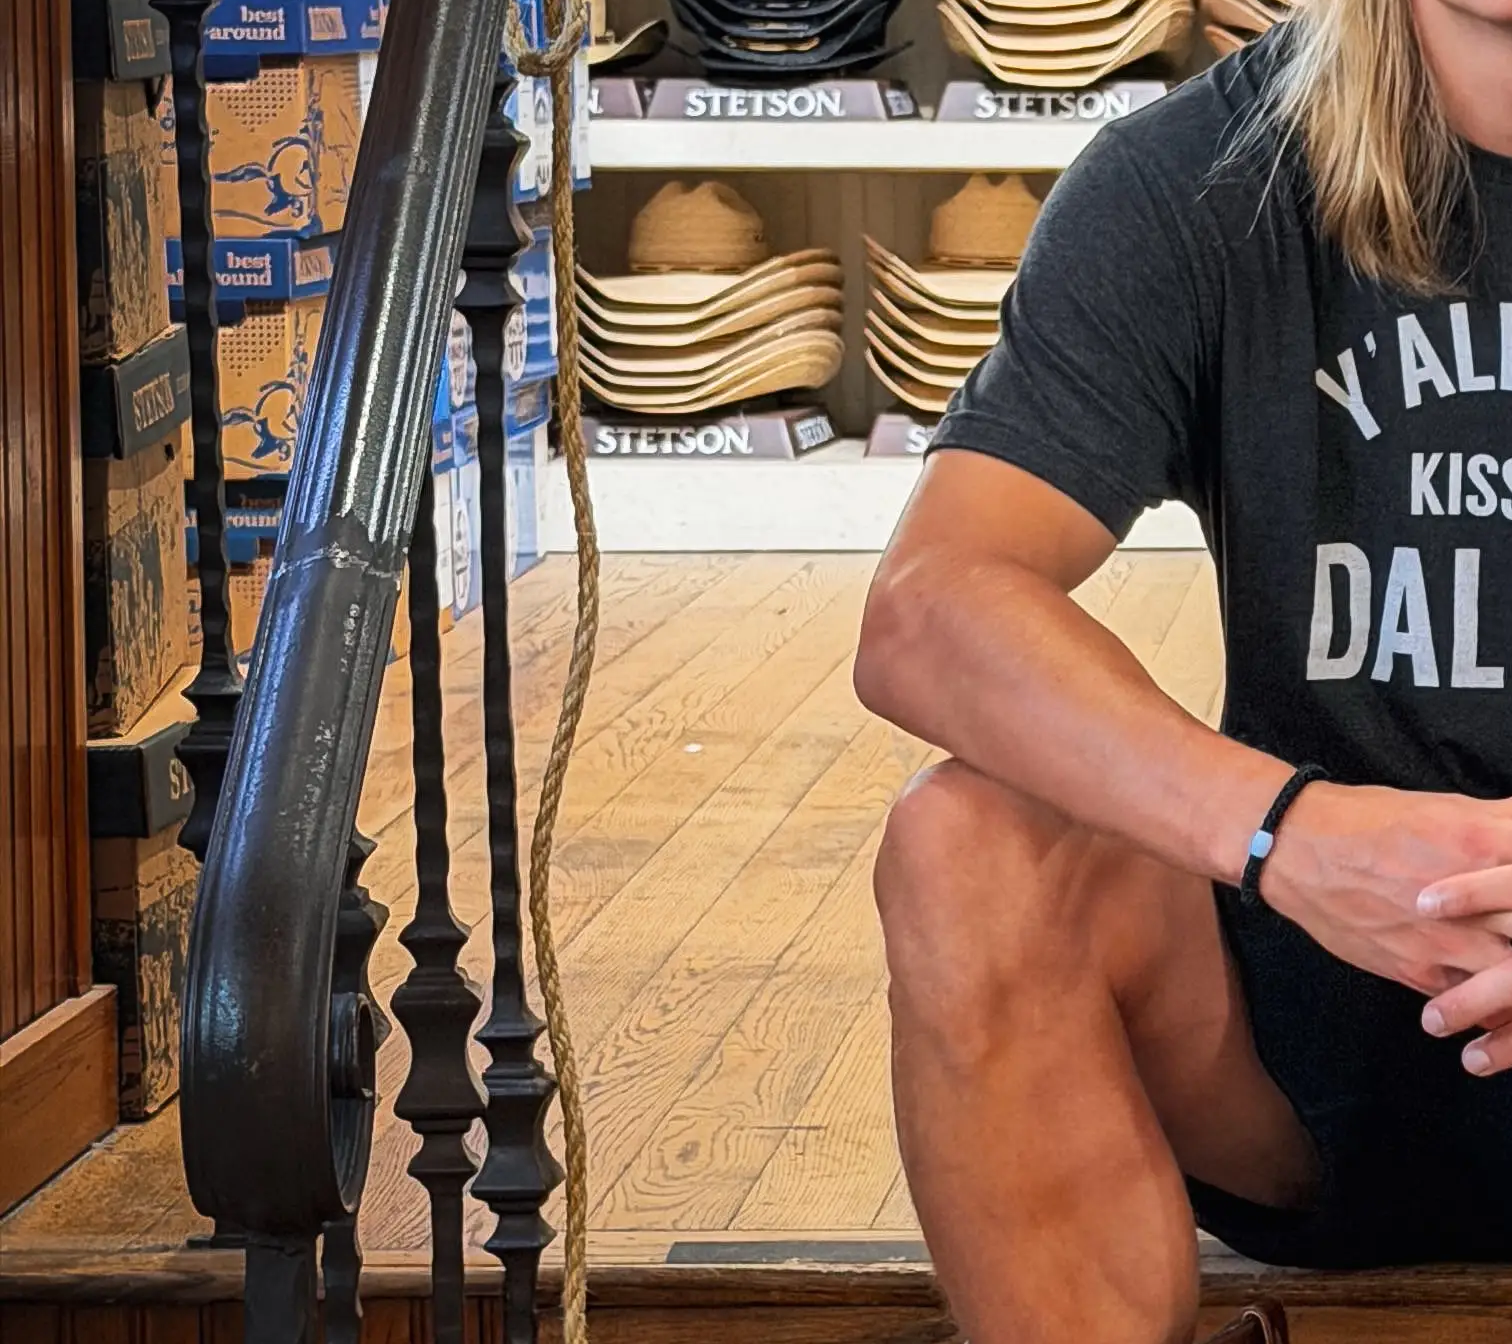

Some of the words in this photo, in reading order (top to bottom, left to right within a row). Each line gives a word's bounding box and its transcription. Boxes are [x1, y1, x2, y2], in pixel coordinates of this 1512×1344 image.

[241, 6, 285, 23] best
[684, 88, 845, 118] STETSON
[974, 90, 1131, 119] STETSON
[227, 252, 271, 269] best
[594, 424, 753, 454] STETSON
